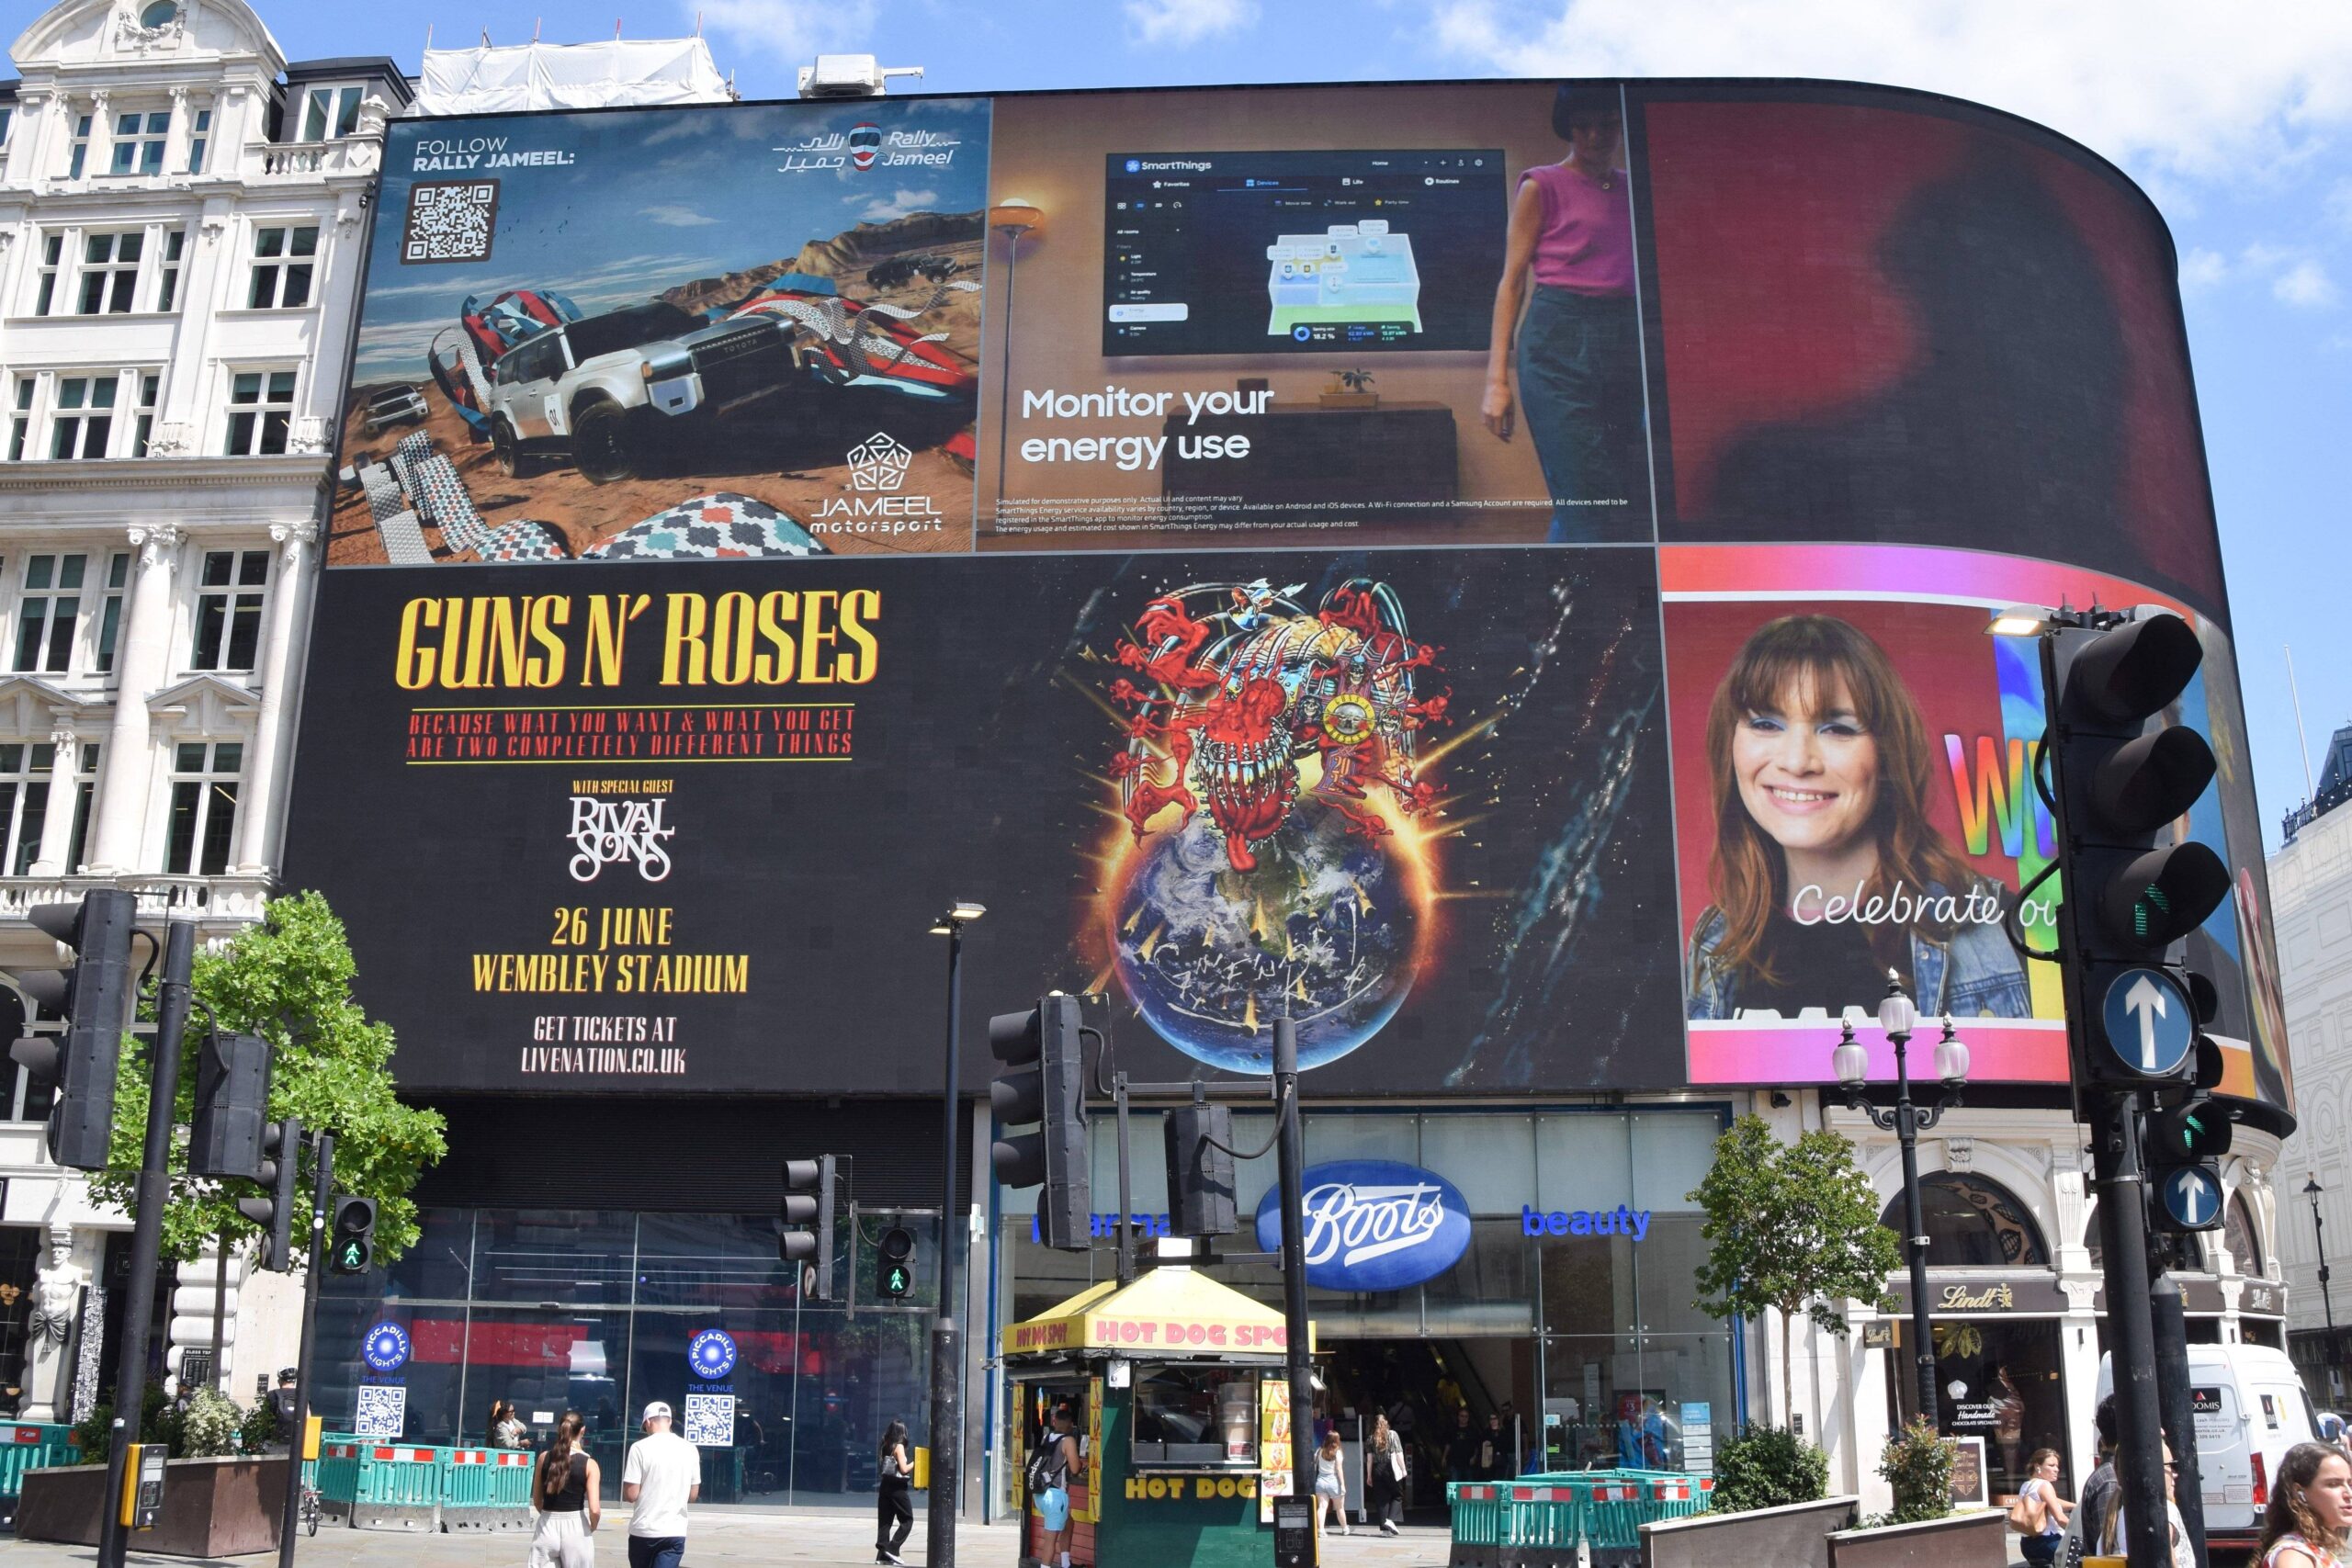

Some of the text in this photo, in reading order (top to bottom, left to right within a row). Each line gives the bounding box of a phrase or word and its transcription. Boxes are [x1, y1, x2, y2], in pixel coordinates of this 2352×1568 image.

[416, 137, 507, 155] FOLLOW
[888, 130, 940, 147] Rally
[413, 151, 574, 171] RALLY JAMEEL:
[777, 155, 845, 172] جميل
[882, 150, 954, 166] Jameel
[1141, 161, 1212, 172] SmartThings
[1023, 386, 1275, 425] Monitor your
[1021, 434, 1250, 471] energy use
[810, 496, 942, 517] JAMEEL
[996, 507, 1038, 515] SmartThings
[1088, 505, 1125, 513] availability
[1148, 505, 1155, 513] by
[1185, 504, 1208, 513] region,
[1451, 500, 1482, 508] Samsung
[1091, 497, 1121, 506] purposes
[809, 517, 942, 536] motorsport
[996, 516, 1029, 525] registered
[1051, 515, 1092, 524] SmartThings
[1193, 523, 1217, 531] Energy
[395, 594, 571, 690] GUNS
[659, 589, 881, 685] ROSES
[409, 709, 855, 735] BECAUSE WHAT YOU WANT & WHAT YOU GET
[406, 733, 853, 758] ARE TWO COMPLETELY DIFFERENT THINGS
[572, 779, 673, 794] WITH SPECIAL GUEST
[566, 796, 675, 840] RIVAL
[569, 829, 672, 882] SONS
[1792, 880, 2005, 925] Celebrate
[551, 907, 673, 951] 26 JUNE
[473, 954, 749, 993] WEMBLEY STADIUM
[533, 1016, 677, 1043] GET TICKETS AT
[521, 1047, 686, 1074] LIVENATION.CO.UK
[1302, 1182, 1443, 1268] Boots
[1522, 1204, 1650, 1241] beauty
[1938, 1285, 2000, 1308] Lindt
[367, 1325, 405, 1354] PICCADILLY
[1016, 1323, 1067, 1348] HOT DOG SPOT
[1096, 1320, 1286, 1347] HOT DOG SPO
[1867, 1328, 1887, 1342] Lindt
[692, 1333, 733, 1361] PICCADILLY
[368, 1352, 402, 1368] LIGHTS
[694, 1359, 729, 1375] LIGHTS
[362, 1375, 405, 1384] THE VENUE
[688, 1383, 734, 1393] THE VENUE
[1958, 1410, 1996, 1420] Handmade
[1028, 1456, 1043, 1490] adidas
[1125, 1477, 1257, 1499] HOT DOG
